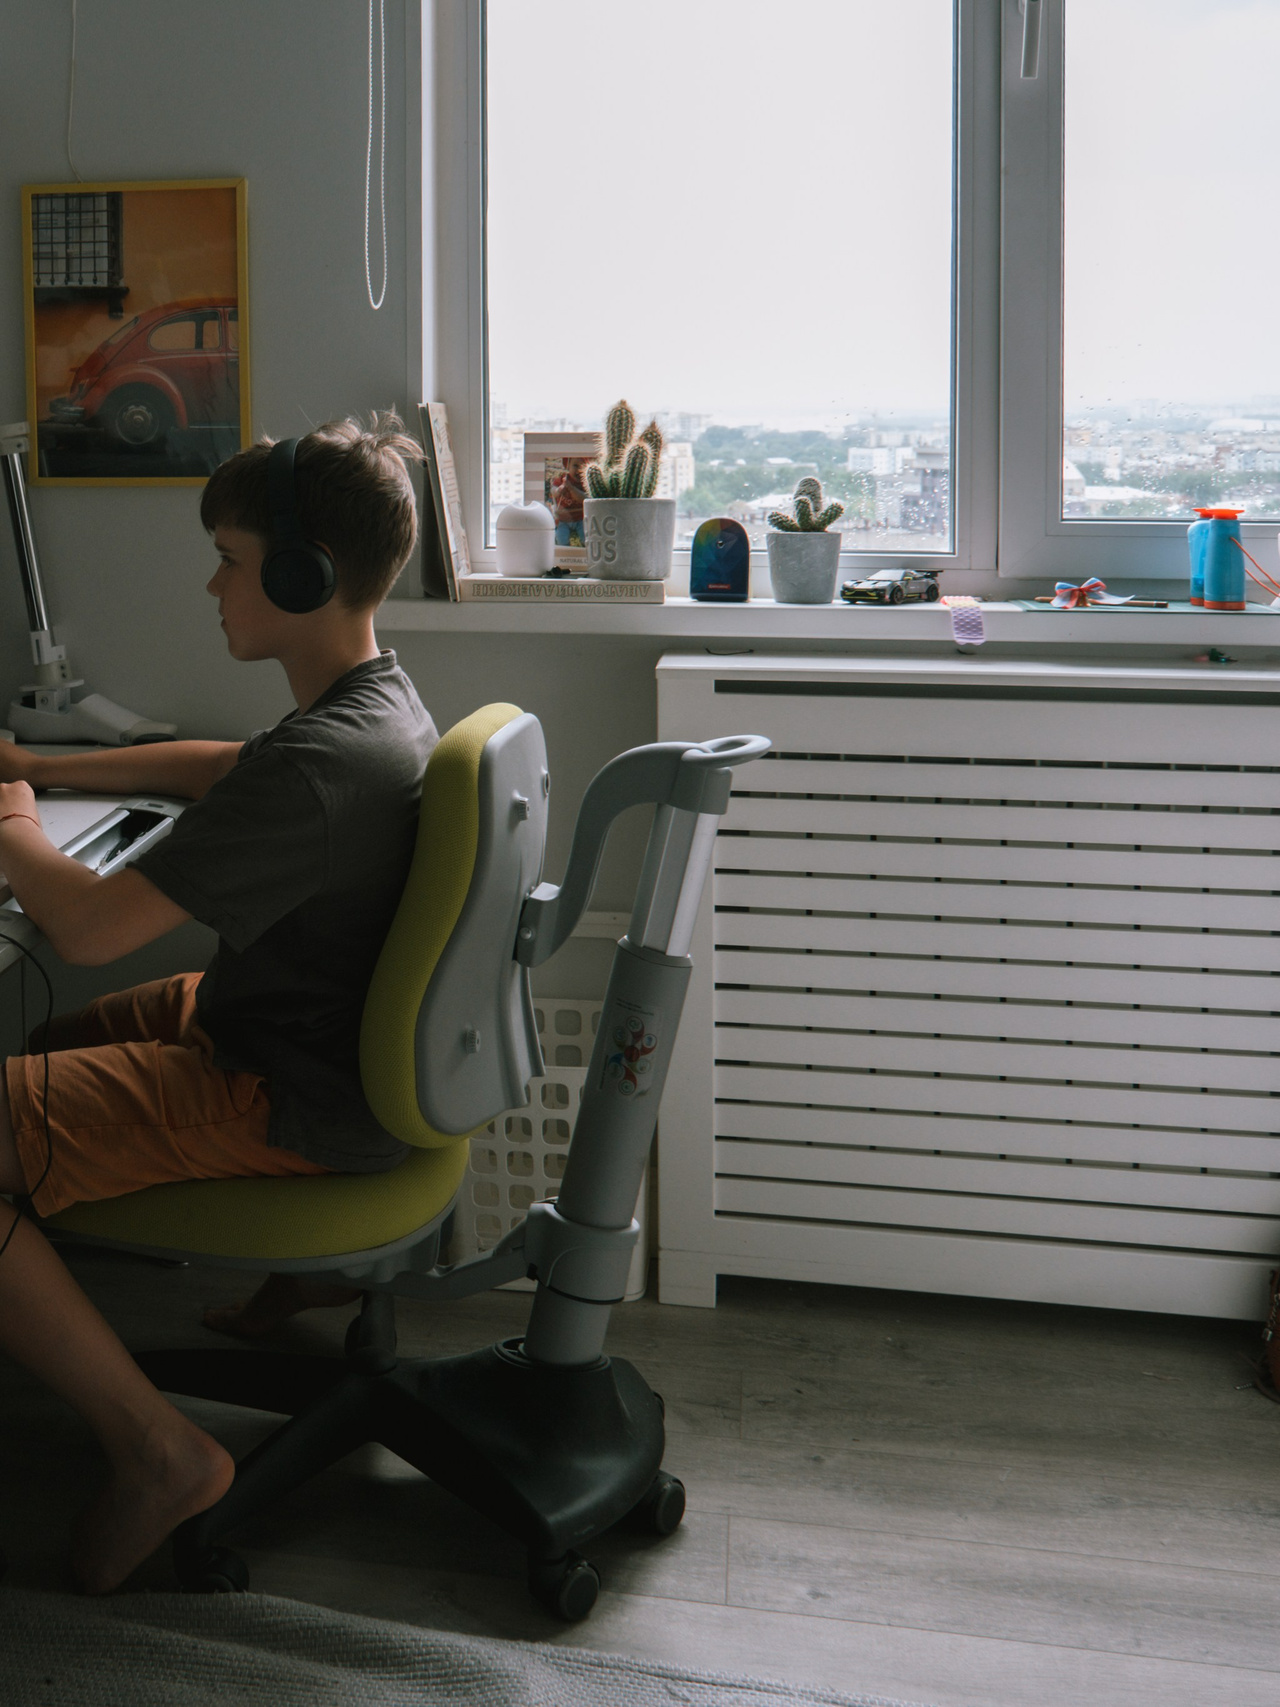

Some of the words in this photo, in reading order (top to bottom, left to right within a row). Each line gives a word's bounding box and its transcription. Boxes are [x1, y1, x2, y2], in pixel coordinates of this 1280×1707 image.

[586, 516, 617, 536] AC
[586, 540, 617, 562] US
[472, 583, 554, 597] АЛЕКСИН
[556, 583, 651, 598] АНАТОЛИЙ
